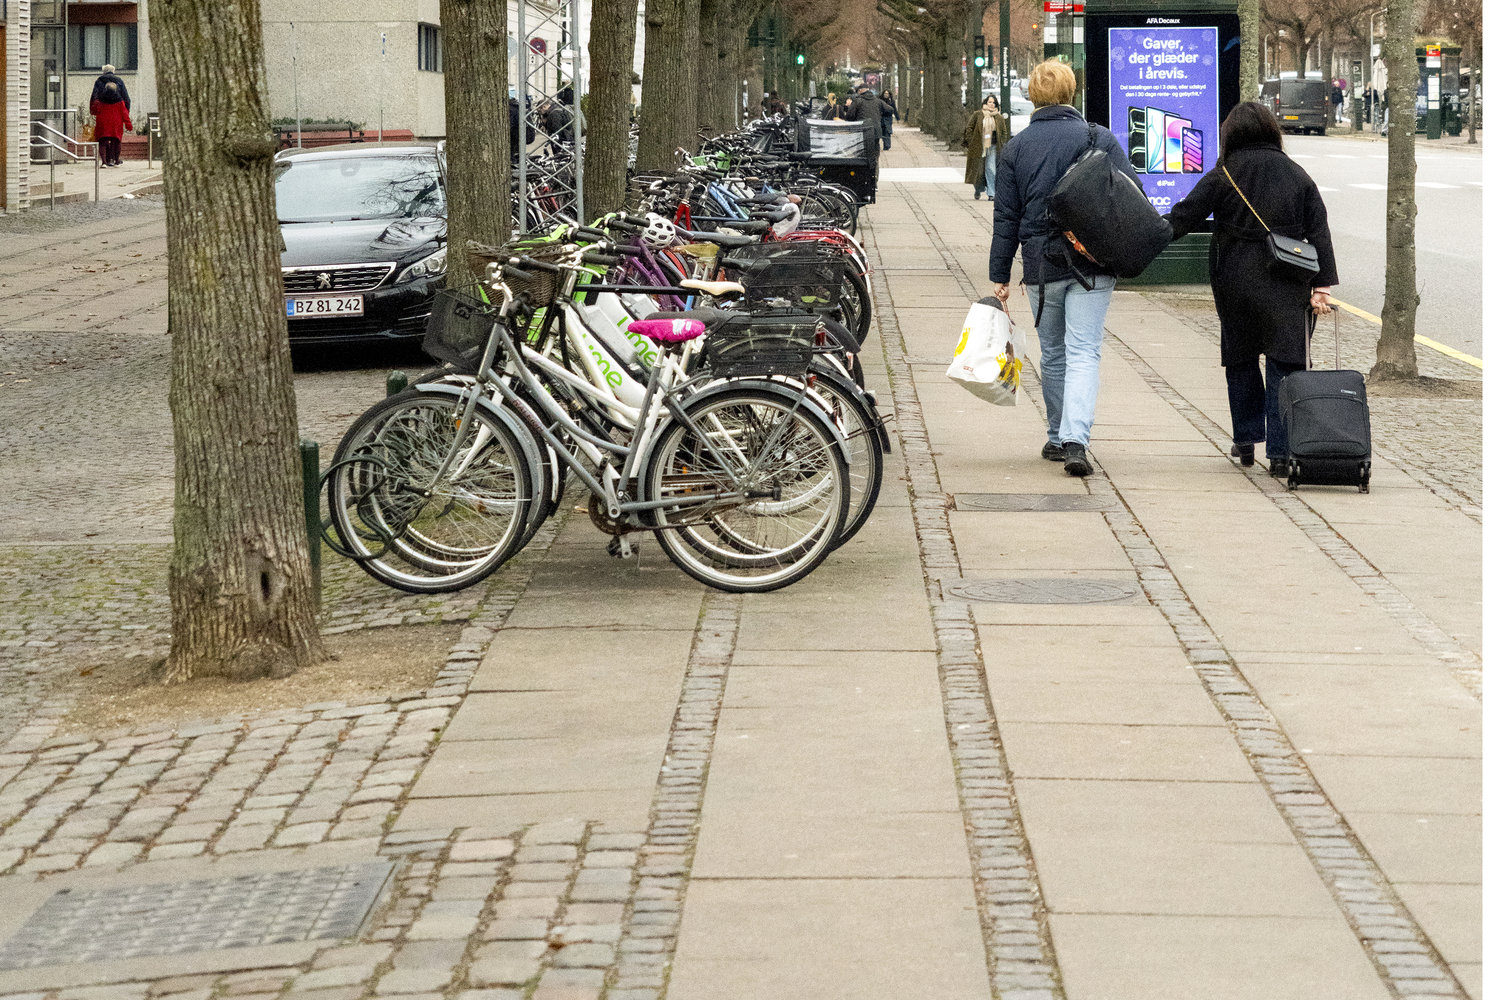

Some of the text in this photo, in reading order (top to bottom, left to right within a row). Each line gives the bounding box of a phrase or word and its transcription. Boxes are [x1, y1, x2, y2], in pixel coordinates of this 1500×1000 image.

[1143, 37, 1183, 51] Gaver,
[1128, 52, 1199, 66] der glæder
[1139, 66, 1188, 79] i årevis.
[296, 299, 360, 313] BZ 81 242
